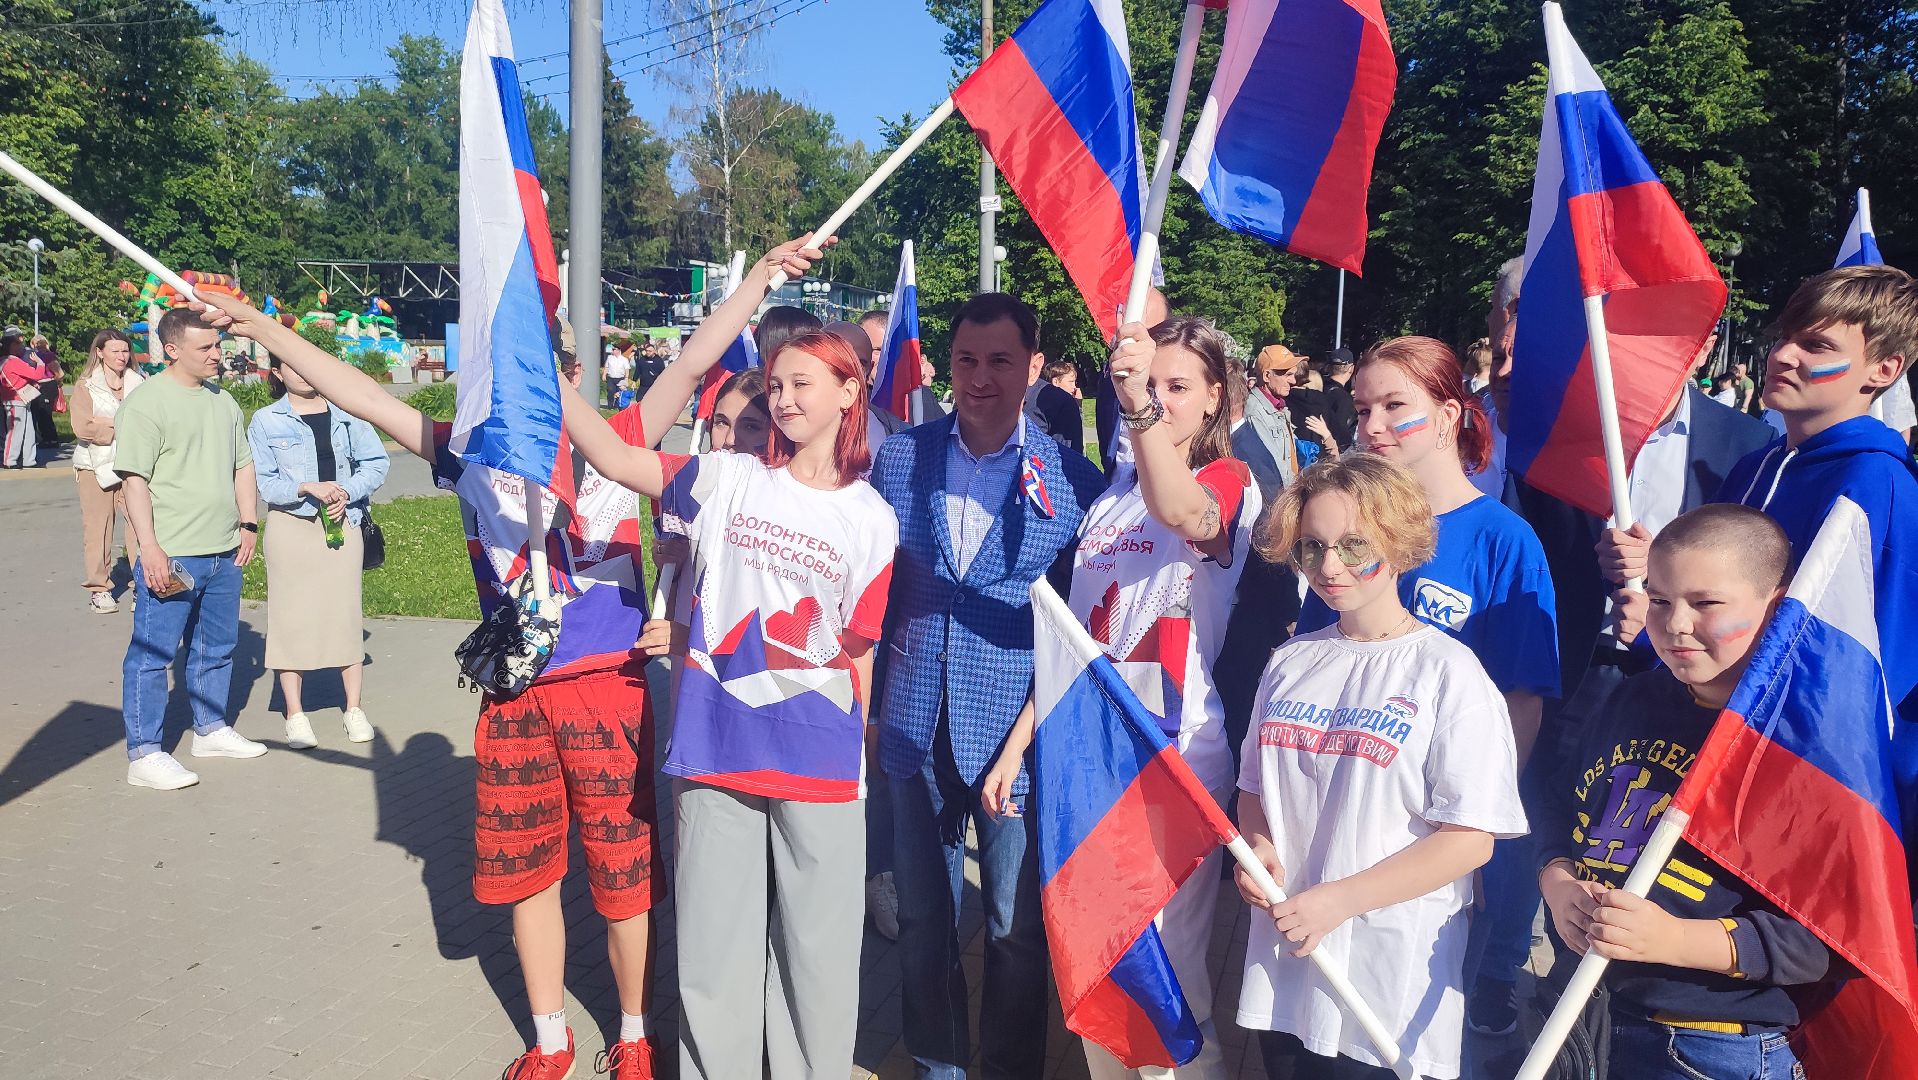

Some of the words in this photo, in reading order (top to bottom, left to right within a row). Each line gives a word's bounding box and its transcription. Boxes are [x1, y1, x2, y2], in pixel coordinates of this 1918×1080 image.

[723, 527, 842, 583] ПОДМОСКОВЬЯ
[732, 512, 843, 564] ВОЛОНТЕРЫ
[744, 557, 764, 571] МЫ
[767, 562, 809, 586] РЯДОМ
[1262, 699, 1333, 727] ОЛОДАЯ
[1325, 731, 1395, 765] ДЕЙСТВИИ
[1574, 756, 1605, 802] LOS
[1610, 739, 1697, 780] ANGEL
